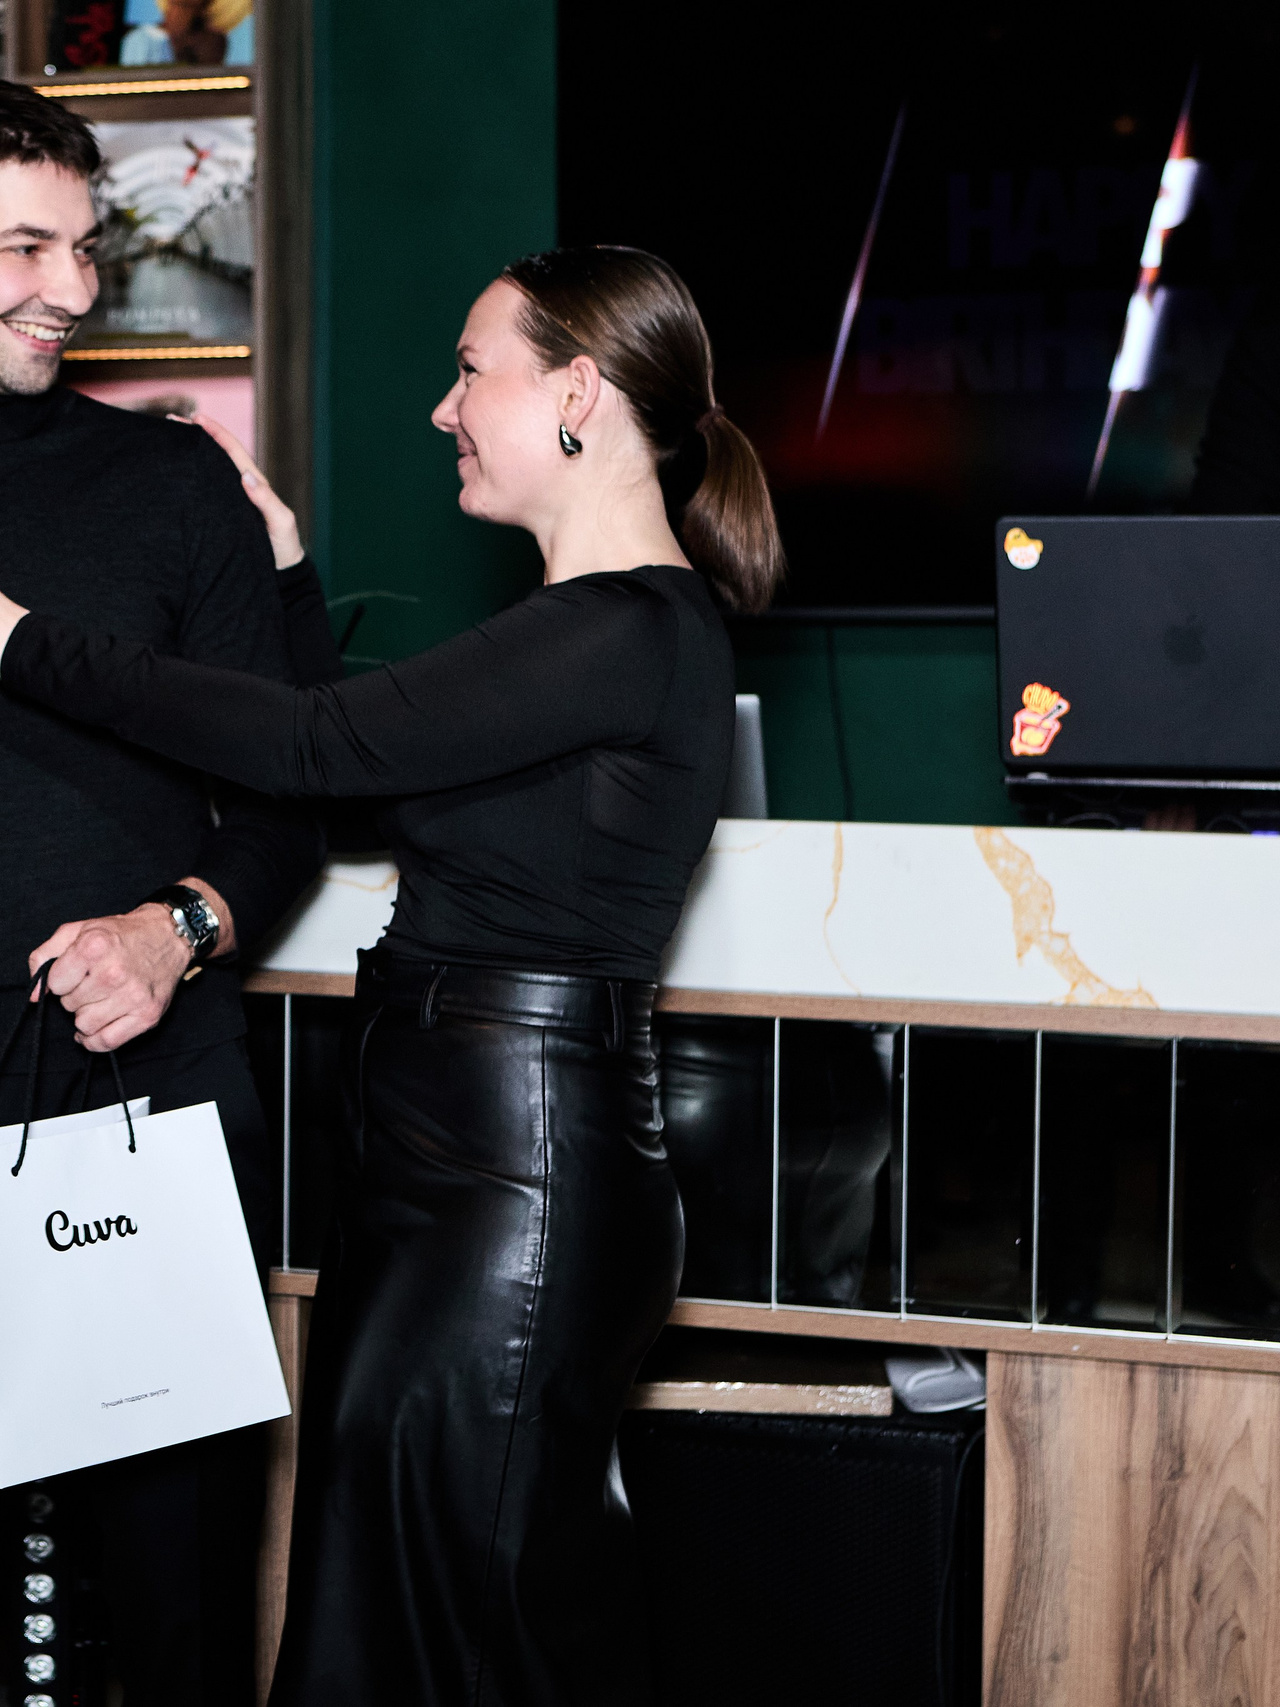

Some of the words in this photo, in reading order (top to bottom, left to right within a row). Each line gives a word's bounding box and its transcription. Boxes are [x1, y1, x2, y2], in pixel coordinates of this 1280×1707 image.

[945, 159, 1258, 270] HAPY
[856, 286, 1258, 393] BIRTHAY
[45, 1210, 138, 1251] Cuva
